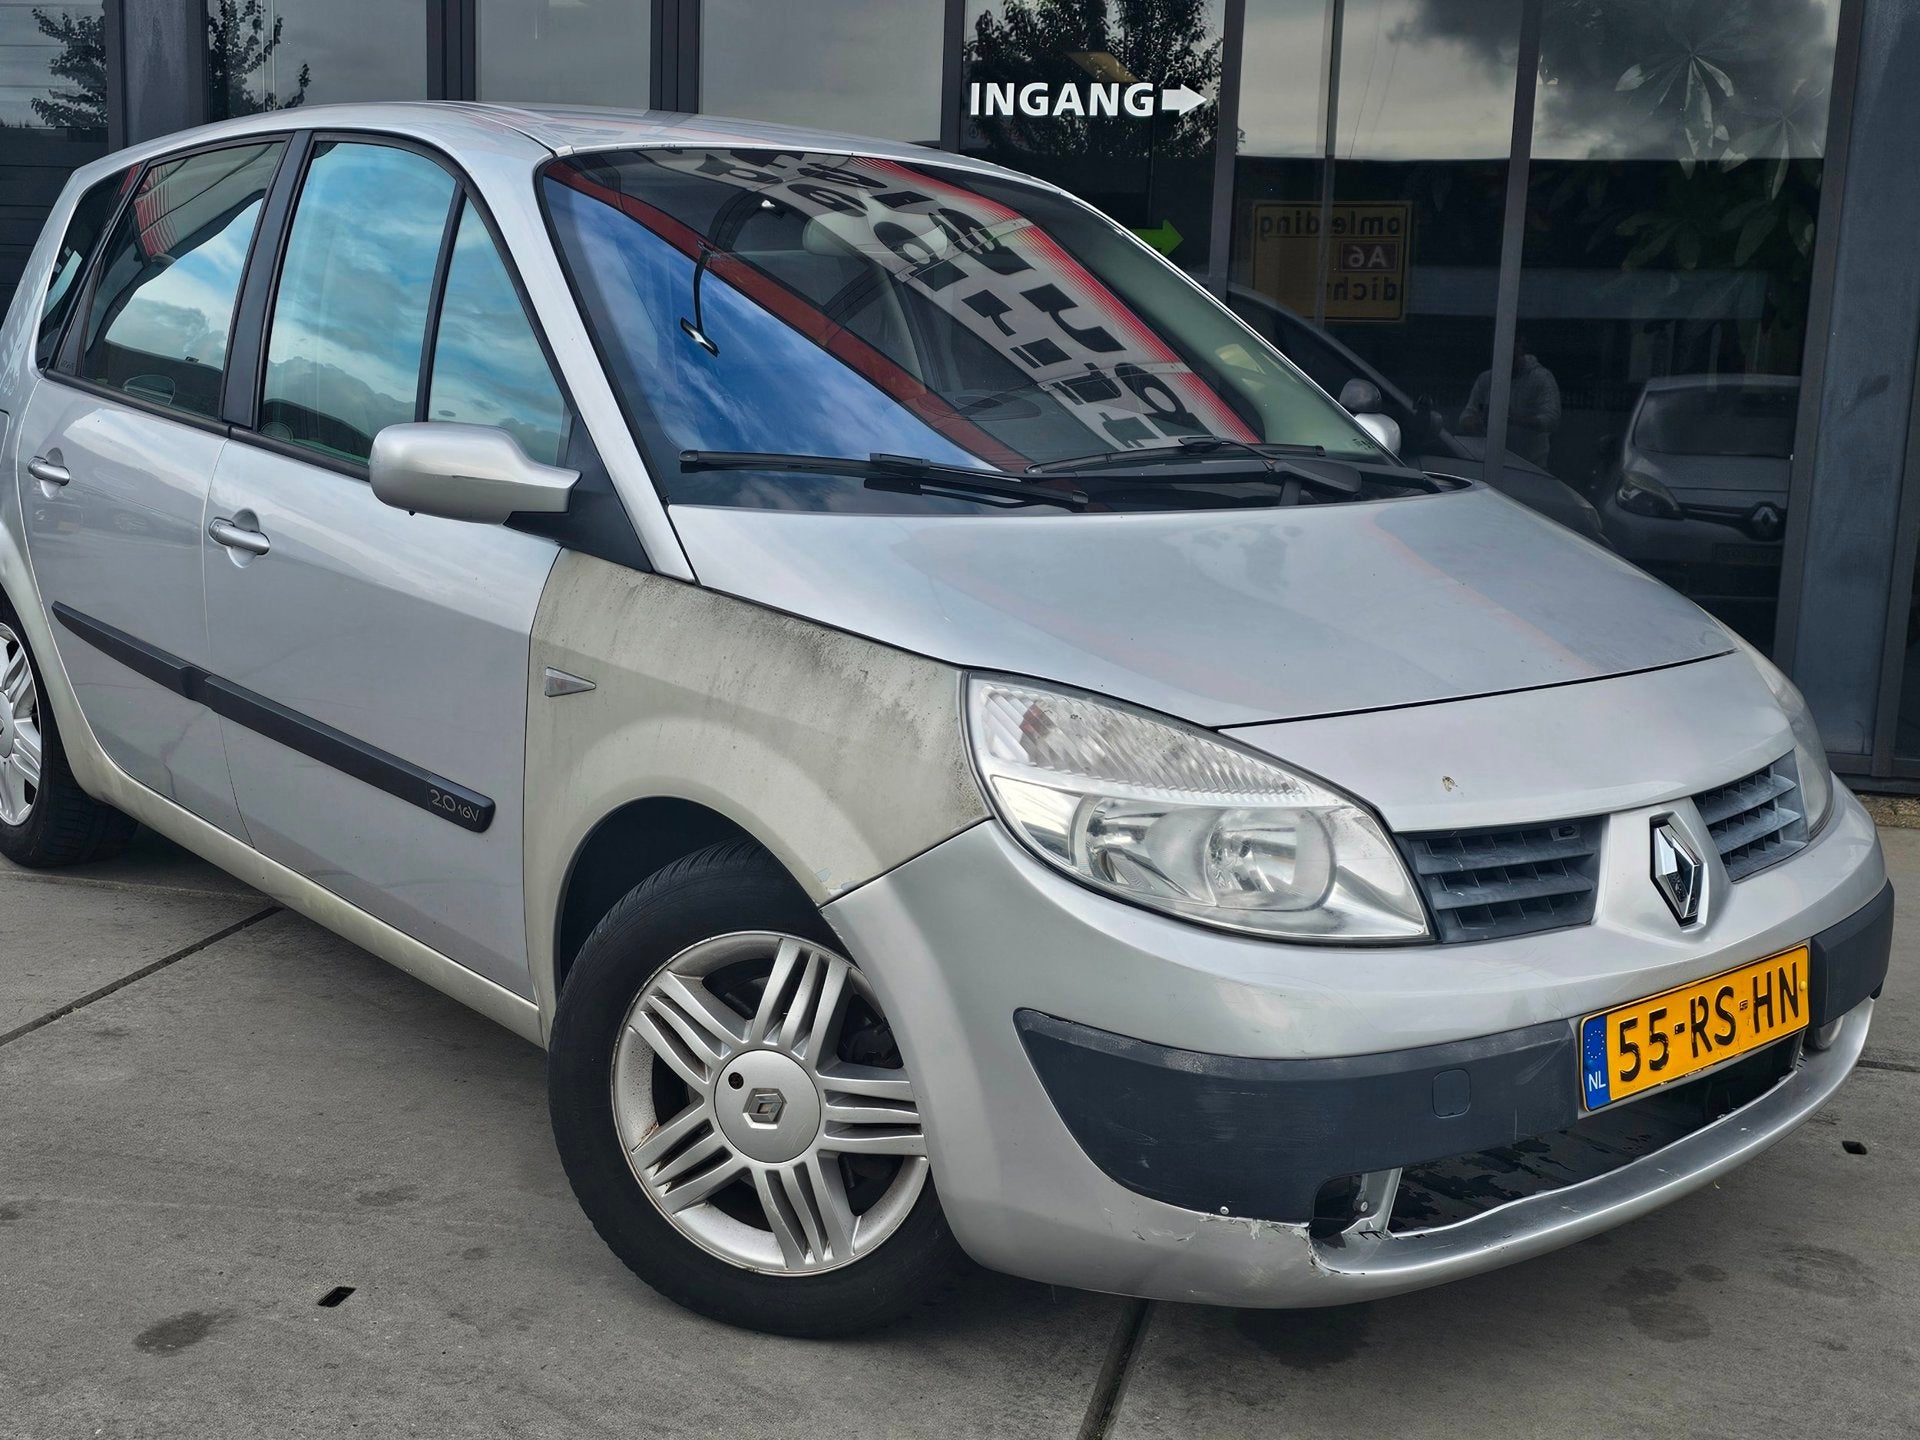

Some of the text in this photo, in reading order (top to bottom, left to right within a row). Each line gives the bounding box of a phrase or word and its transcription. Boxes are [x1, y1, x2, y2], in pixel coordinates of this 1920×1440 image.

[969, 81, 1155, 117] INGANG
[430, 788, 480, 822] 2.0 16V
[1618, 961, 1800, 1083] 55-RS-HN
[1588, 1070, 1607, 1093] NL
